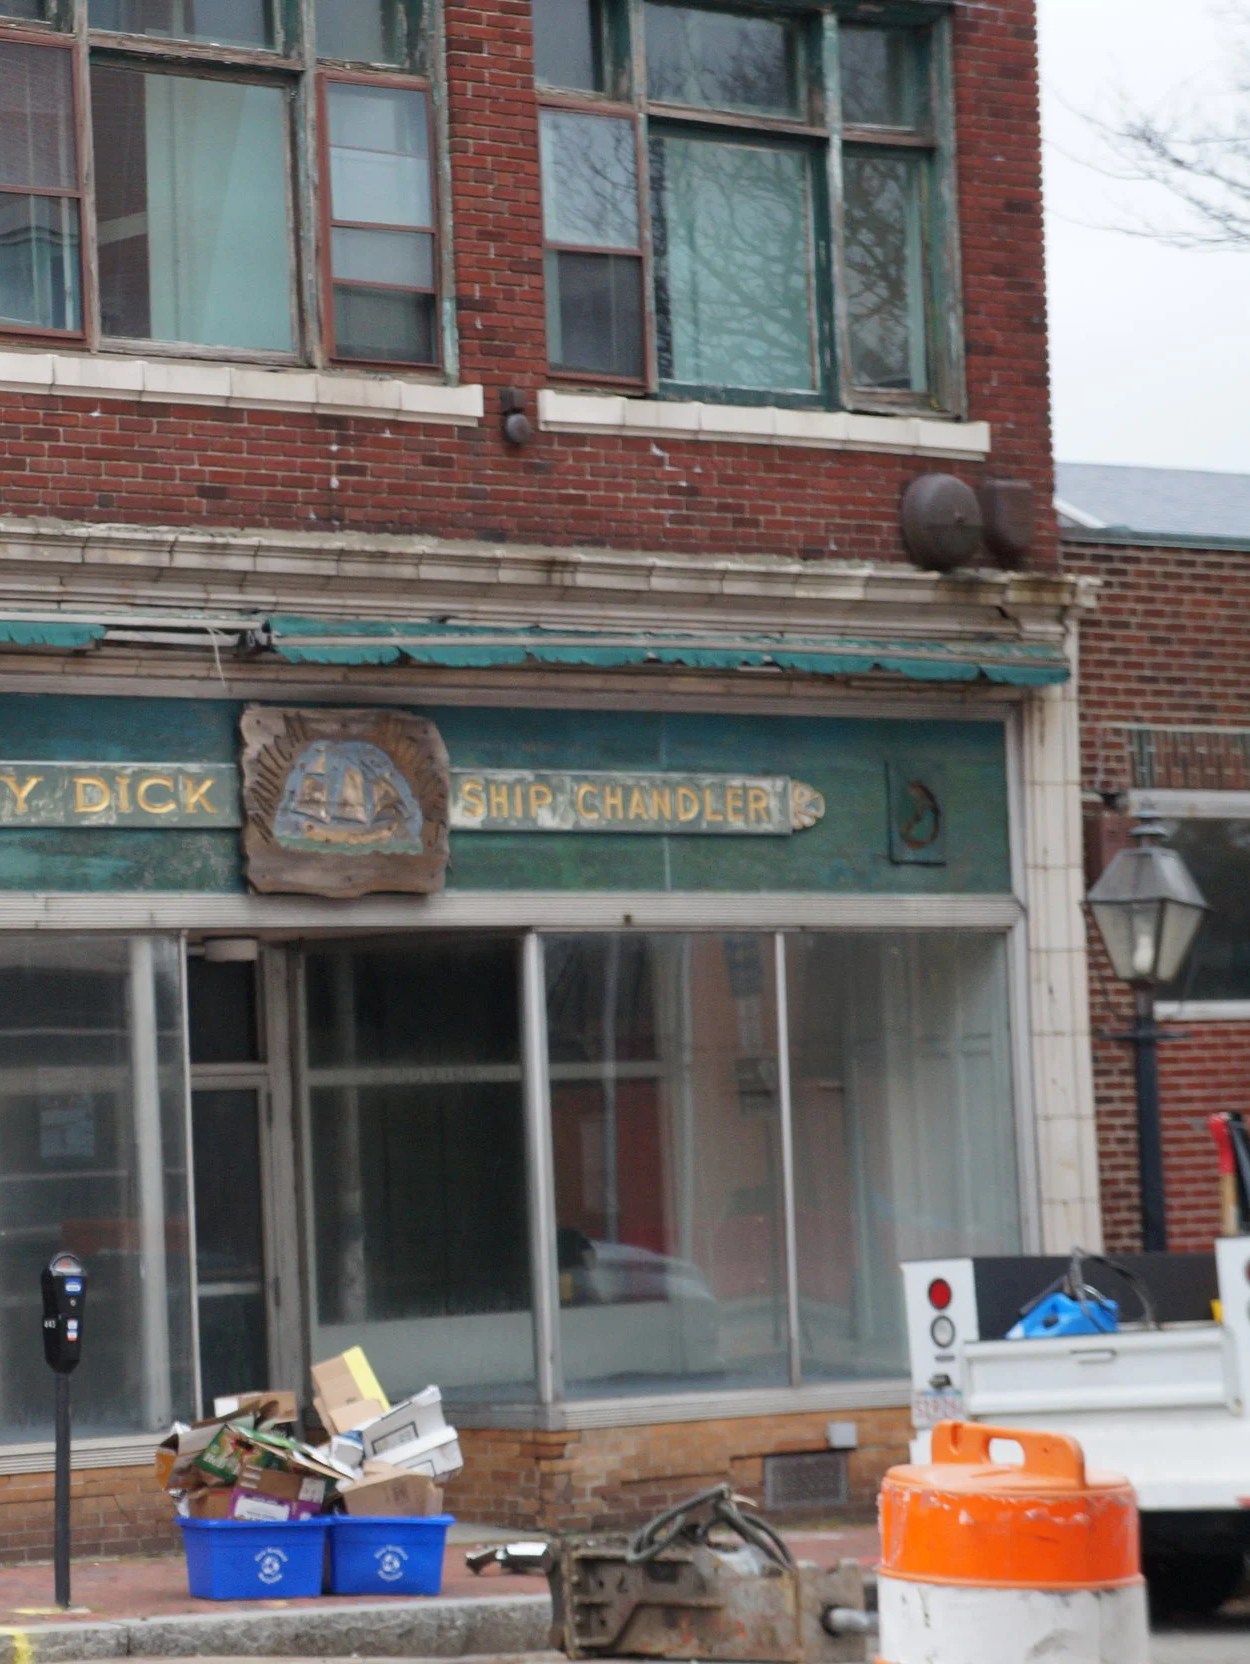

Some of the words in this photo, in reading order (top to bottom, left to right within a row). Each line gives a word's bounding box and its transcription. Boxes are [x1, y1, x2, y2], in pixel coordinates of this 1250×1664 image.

[73, 776, 219, 815] DICK
[461, 781, 552, 819] SHIP
[576, 783, 773, 823] CHANDLER
